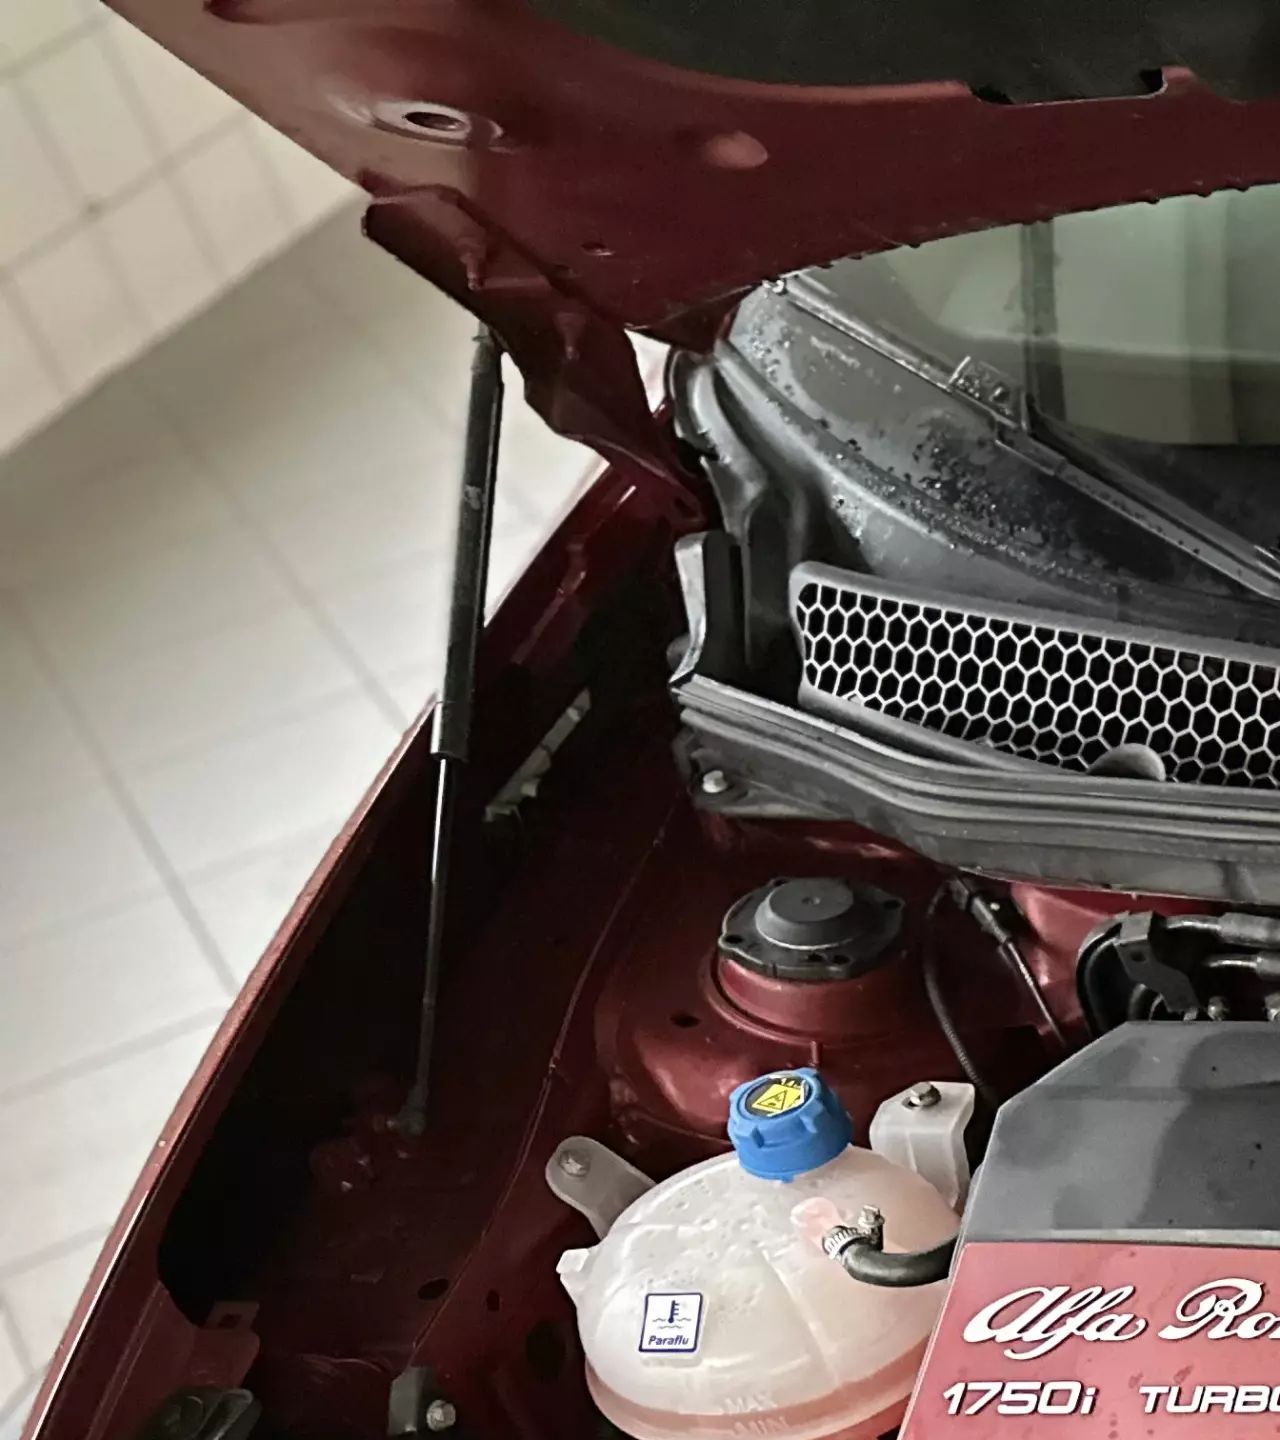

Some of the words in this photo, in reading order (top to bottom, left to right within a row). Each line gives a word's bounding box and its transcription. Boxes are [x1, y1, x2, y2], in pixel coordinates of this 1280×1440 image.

[648, 1334, 690, 1346] Paraflu
[962, 1284, 1147, 1361] Alfa
[942, 1381, 1096, 1417] 1750i
